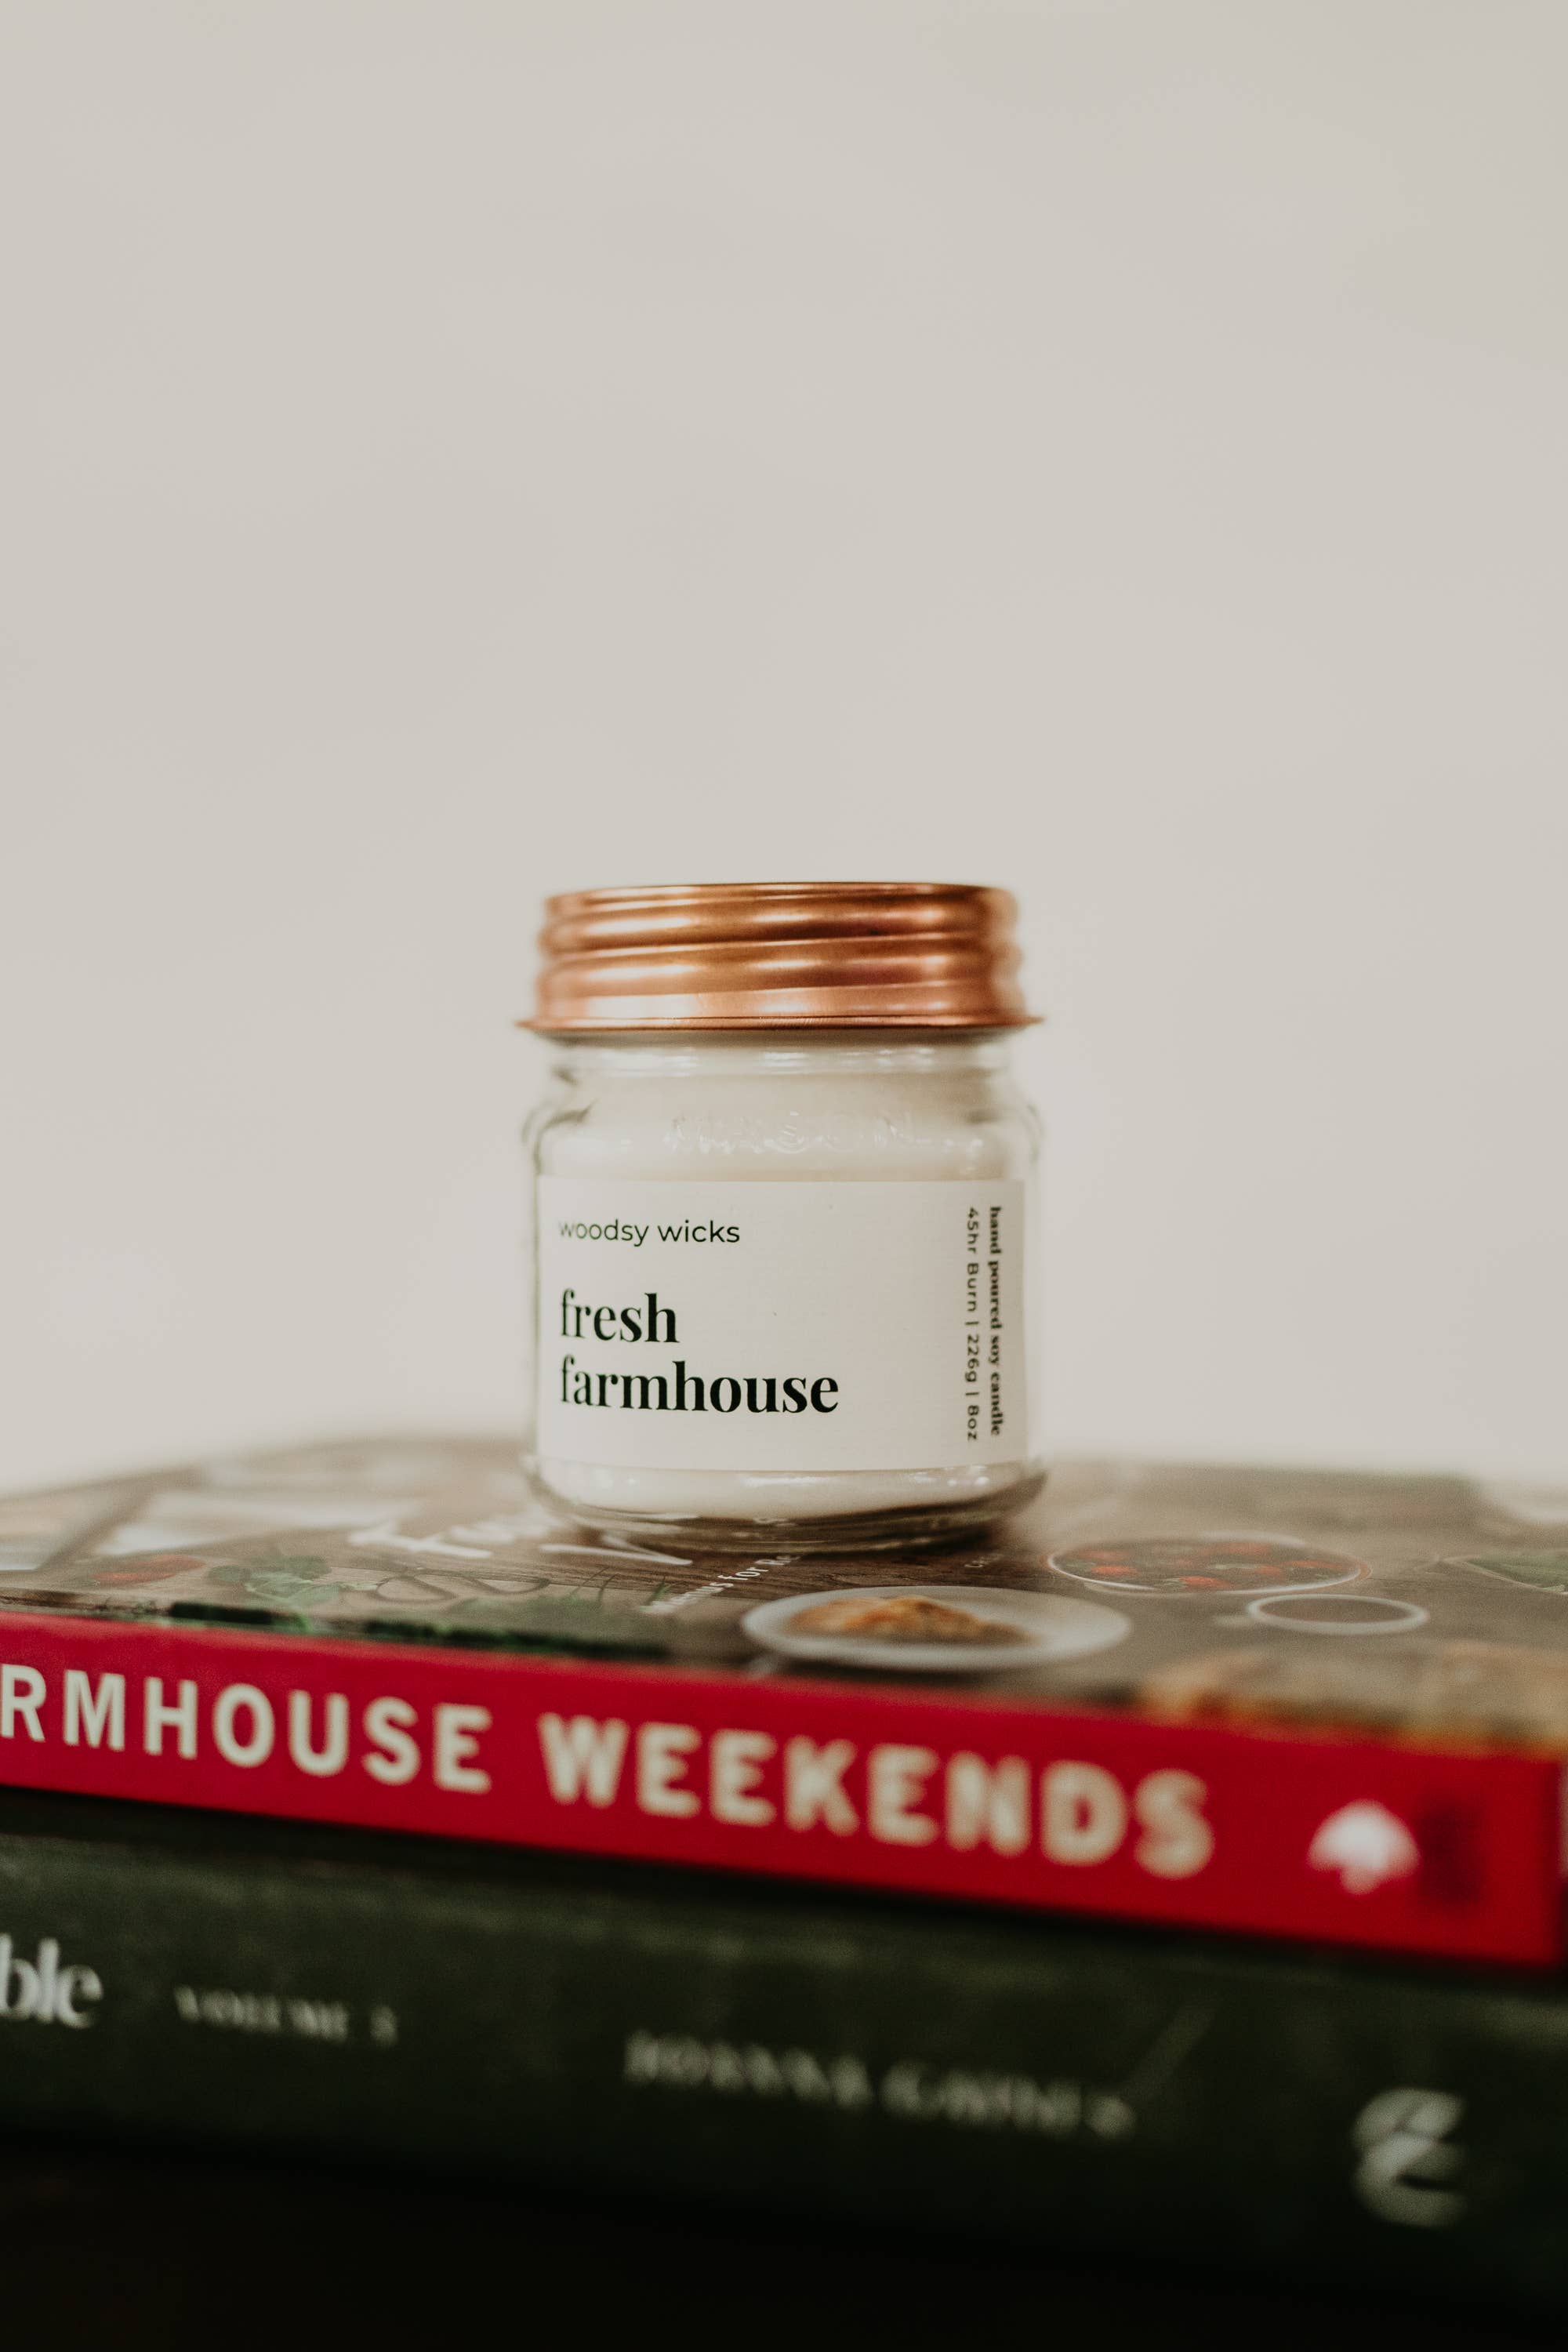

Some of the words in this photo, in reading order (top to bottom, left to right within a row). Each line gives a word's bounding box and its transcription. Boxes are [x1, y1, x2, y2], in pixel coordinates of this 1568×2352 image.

[560, 1219, 650, 1249] woodsy
[657, 1219, 742, 1244] wicks
[967, 1207, 980, 1255] 45hr
[989, 1207, 1003, 1255] hand
[967, 1262, 980, 1313] Burn
[988, 1261, 1004, 1330] poured
[561, 1288, 681, 1344] fresh
[964, 1334, 981, 1384] 226g
[988, 1335, 1002, 1367] soy
[561, 1355, 840, 1414] farmhouse
[990, 1372, 1004, 1436] candle
[967, 1405, 981, 1442] 8oz
[717, 1567, 768, 1581] for
[0, 1664, 492, 1795] RMHOUSE
[538, 1712, 1215, 1879] WEEKENDS
